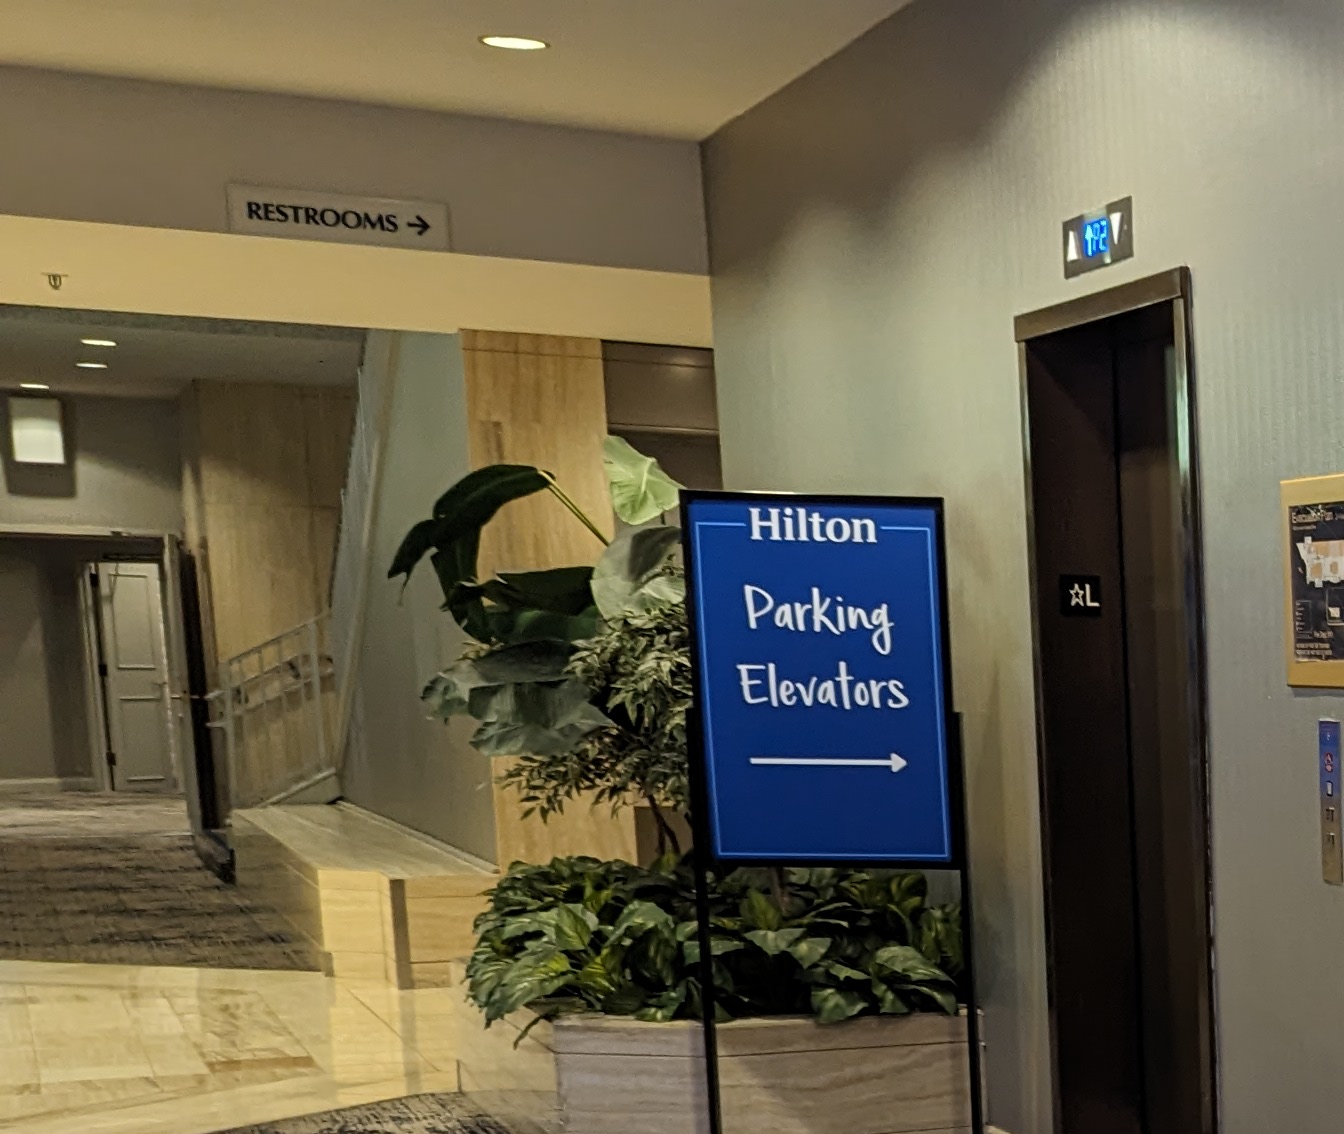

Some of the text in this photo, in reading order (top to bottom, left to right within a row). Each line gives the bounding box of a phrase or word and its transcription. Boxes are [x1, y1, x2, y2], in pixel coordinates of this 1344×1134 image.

[246, 201, 399, 233] RESTROOMS
[749, 507, 877, 543] Hilton
[744, 584, 894, 655] Parking
[736, 661, 909, 709] Elevators
